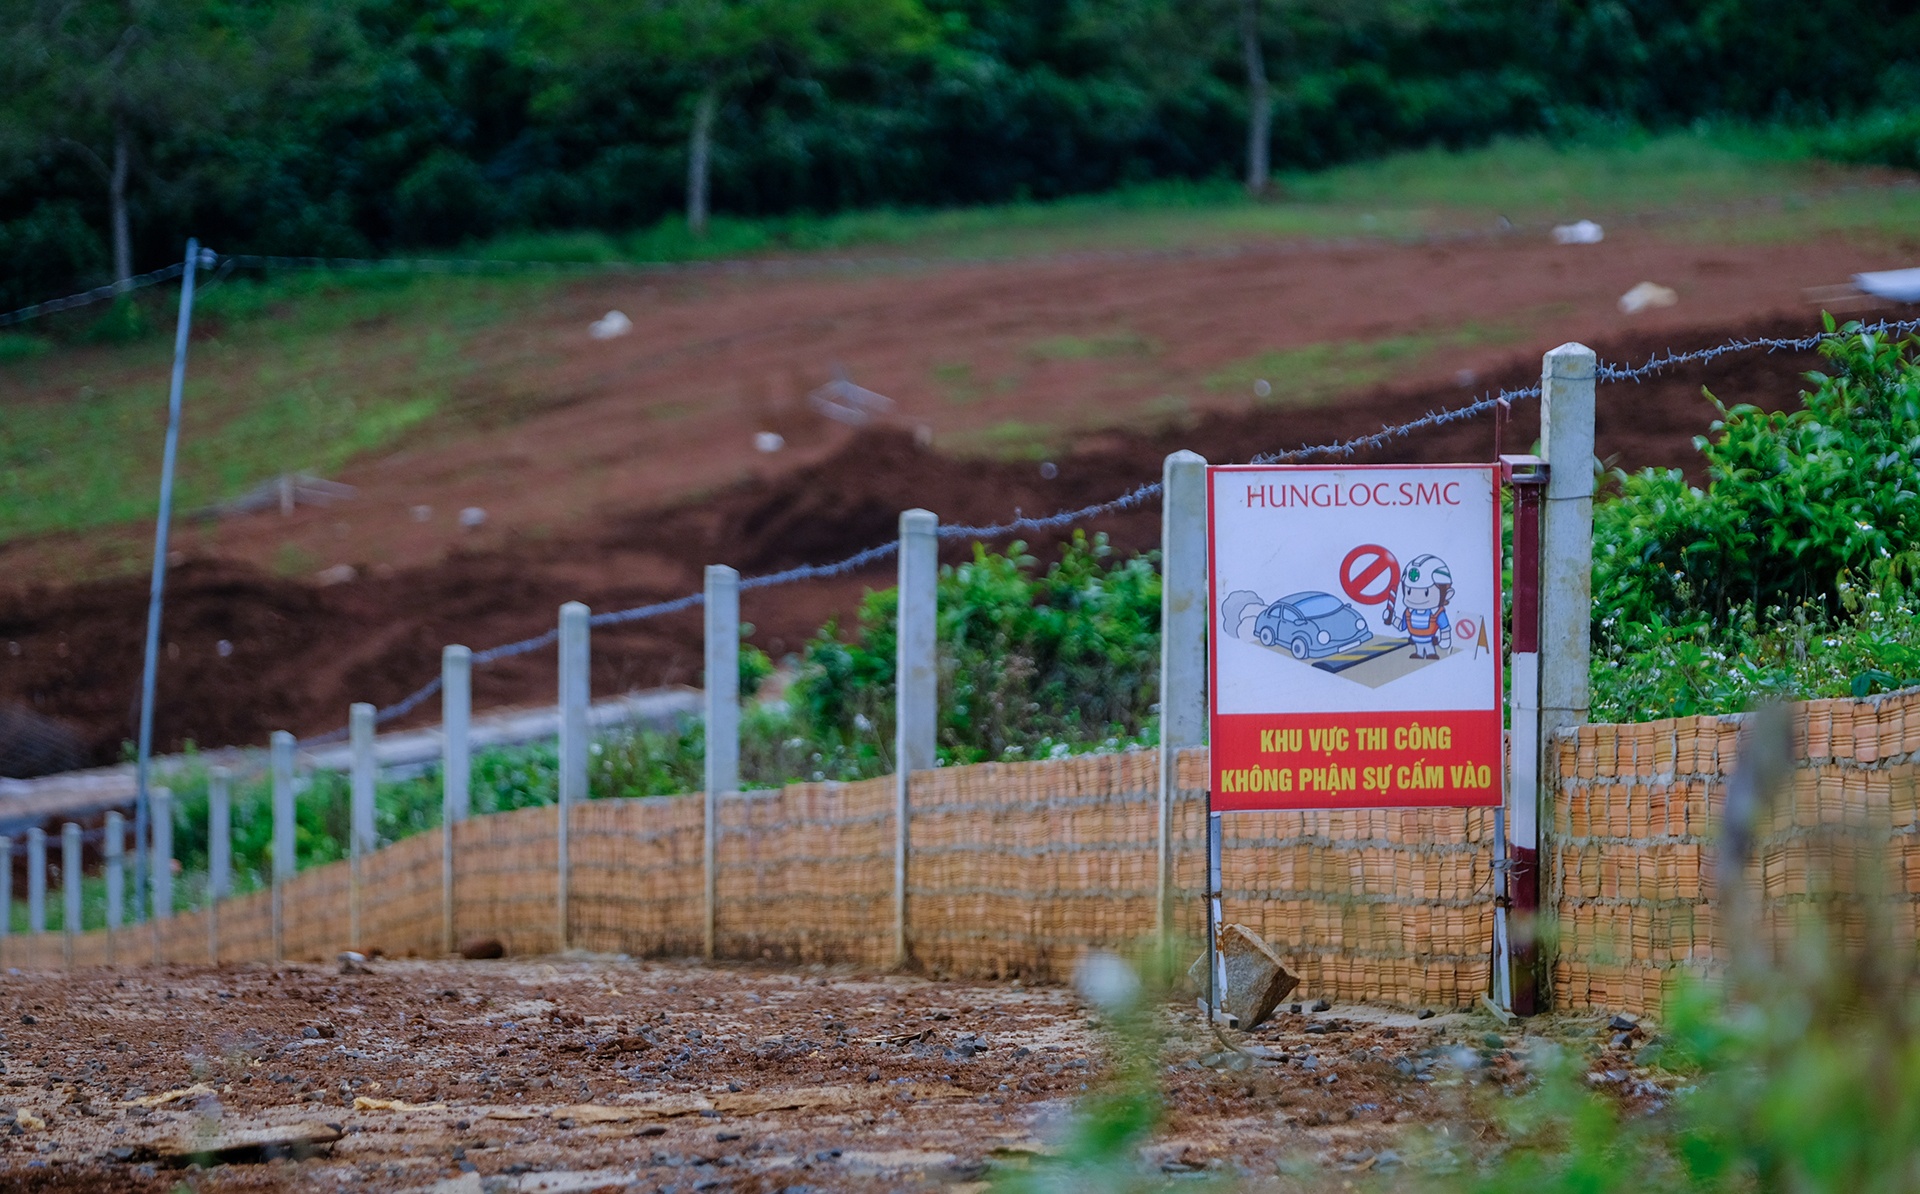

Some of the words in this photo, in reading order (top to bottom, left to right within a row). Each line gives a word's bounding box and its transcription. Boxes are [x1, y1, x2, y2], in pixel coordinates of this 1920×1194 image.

[1246, 482, 1461, 508] HUNGLOC.SMC
[1260, 729, 1302, 753] KHU
[1309, 726, 1349, 756] VỰC
[1355, 727, 1388, 751] THI
[1394, 722, 1452, 750] CÔNG
[1221, 764, 1293, 793] KHÔNG
[1299, 763, 1356, 796] PHẬN
[1362, 764, 1393, 795] SỰ
[1396, 758, 1444, 790] CẤM
[1450, 760, 1491, 789] VÀO
